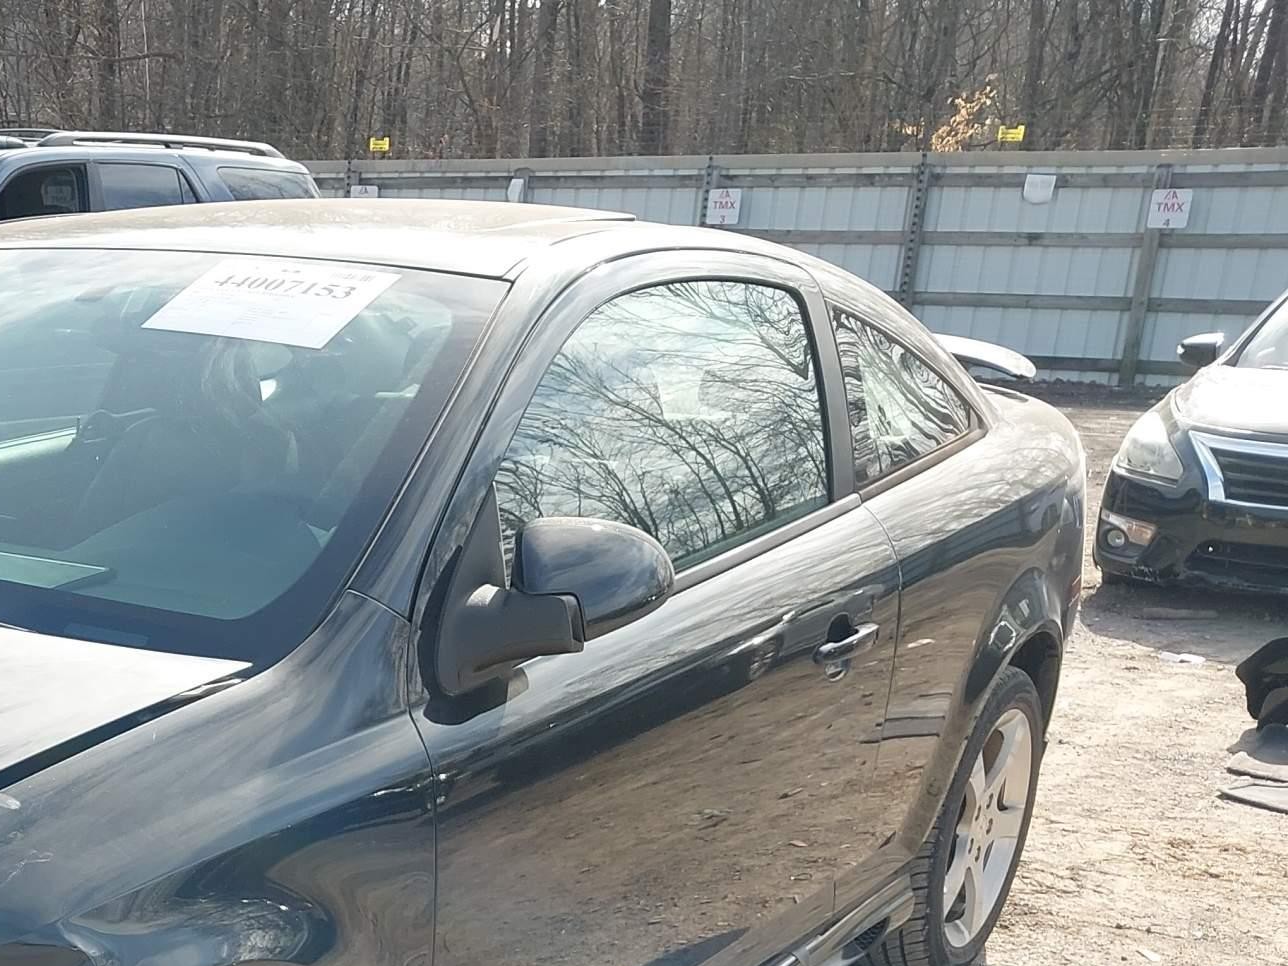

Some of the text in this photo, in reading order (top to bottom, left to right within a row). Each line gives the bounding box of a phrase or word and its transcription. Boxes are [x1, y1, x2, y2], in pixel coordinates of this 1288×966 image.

[713, 200, 735, 209] TMX
[1157, 203, 1184, 213] TMX
[214, 275, 357, 299] 44007153
